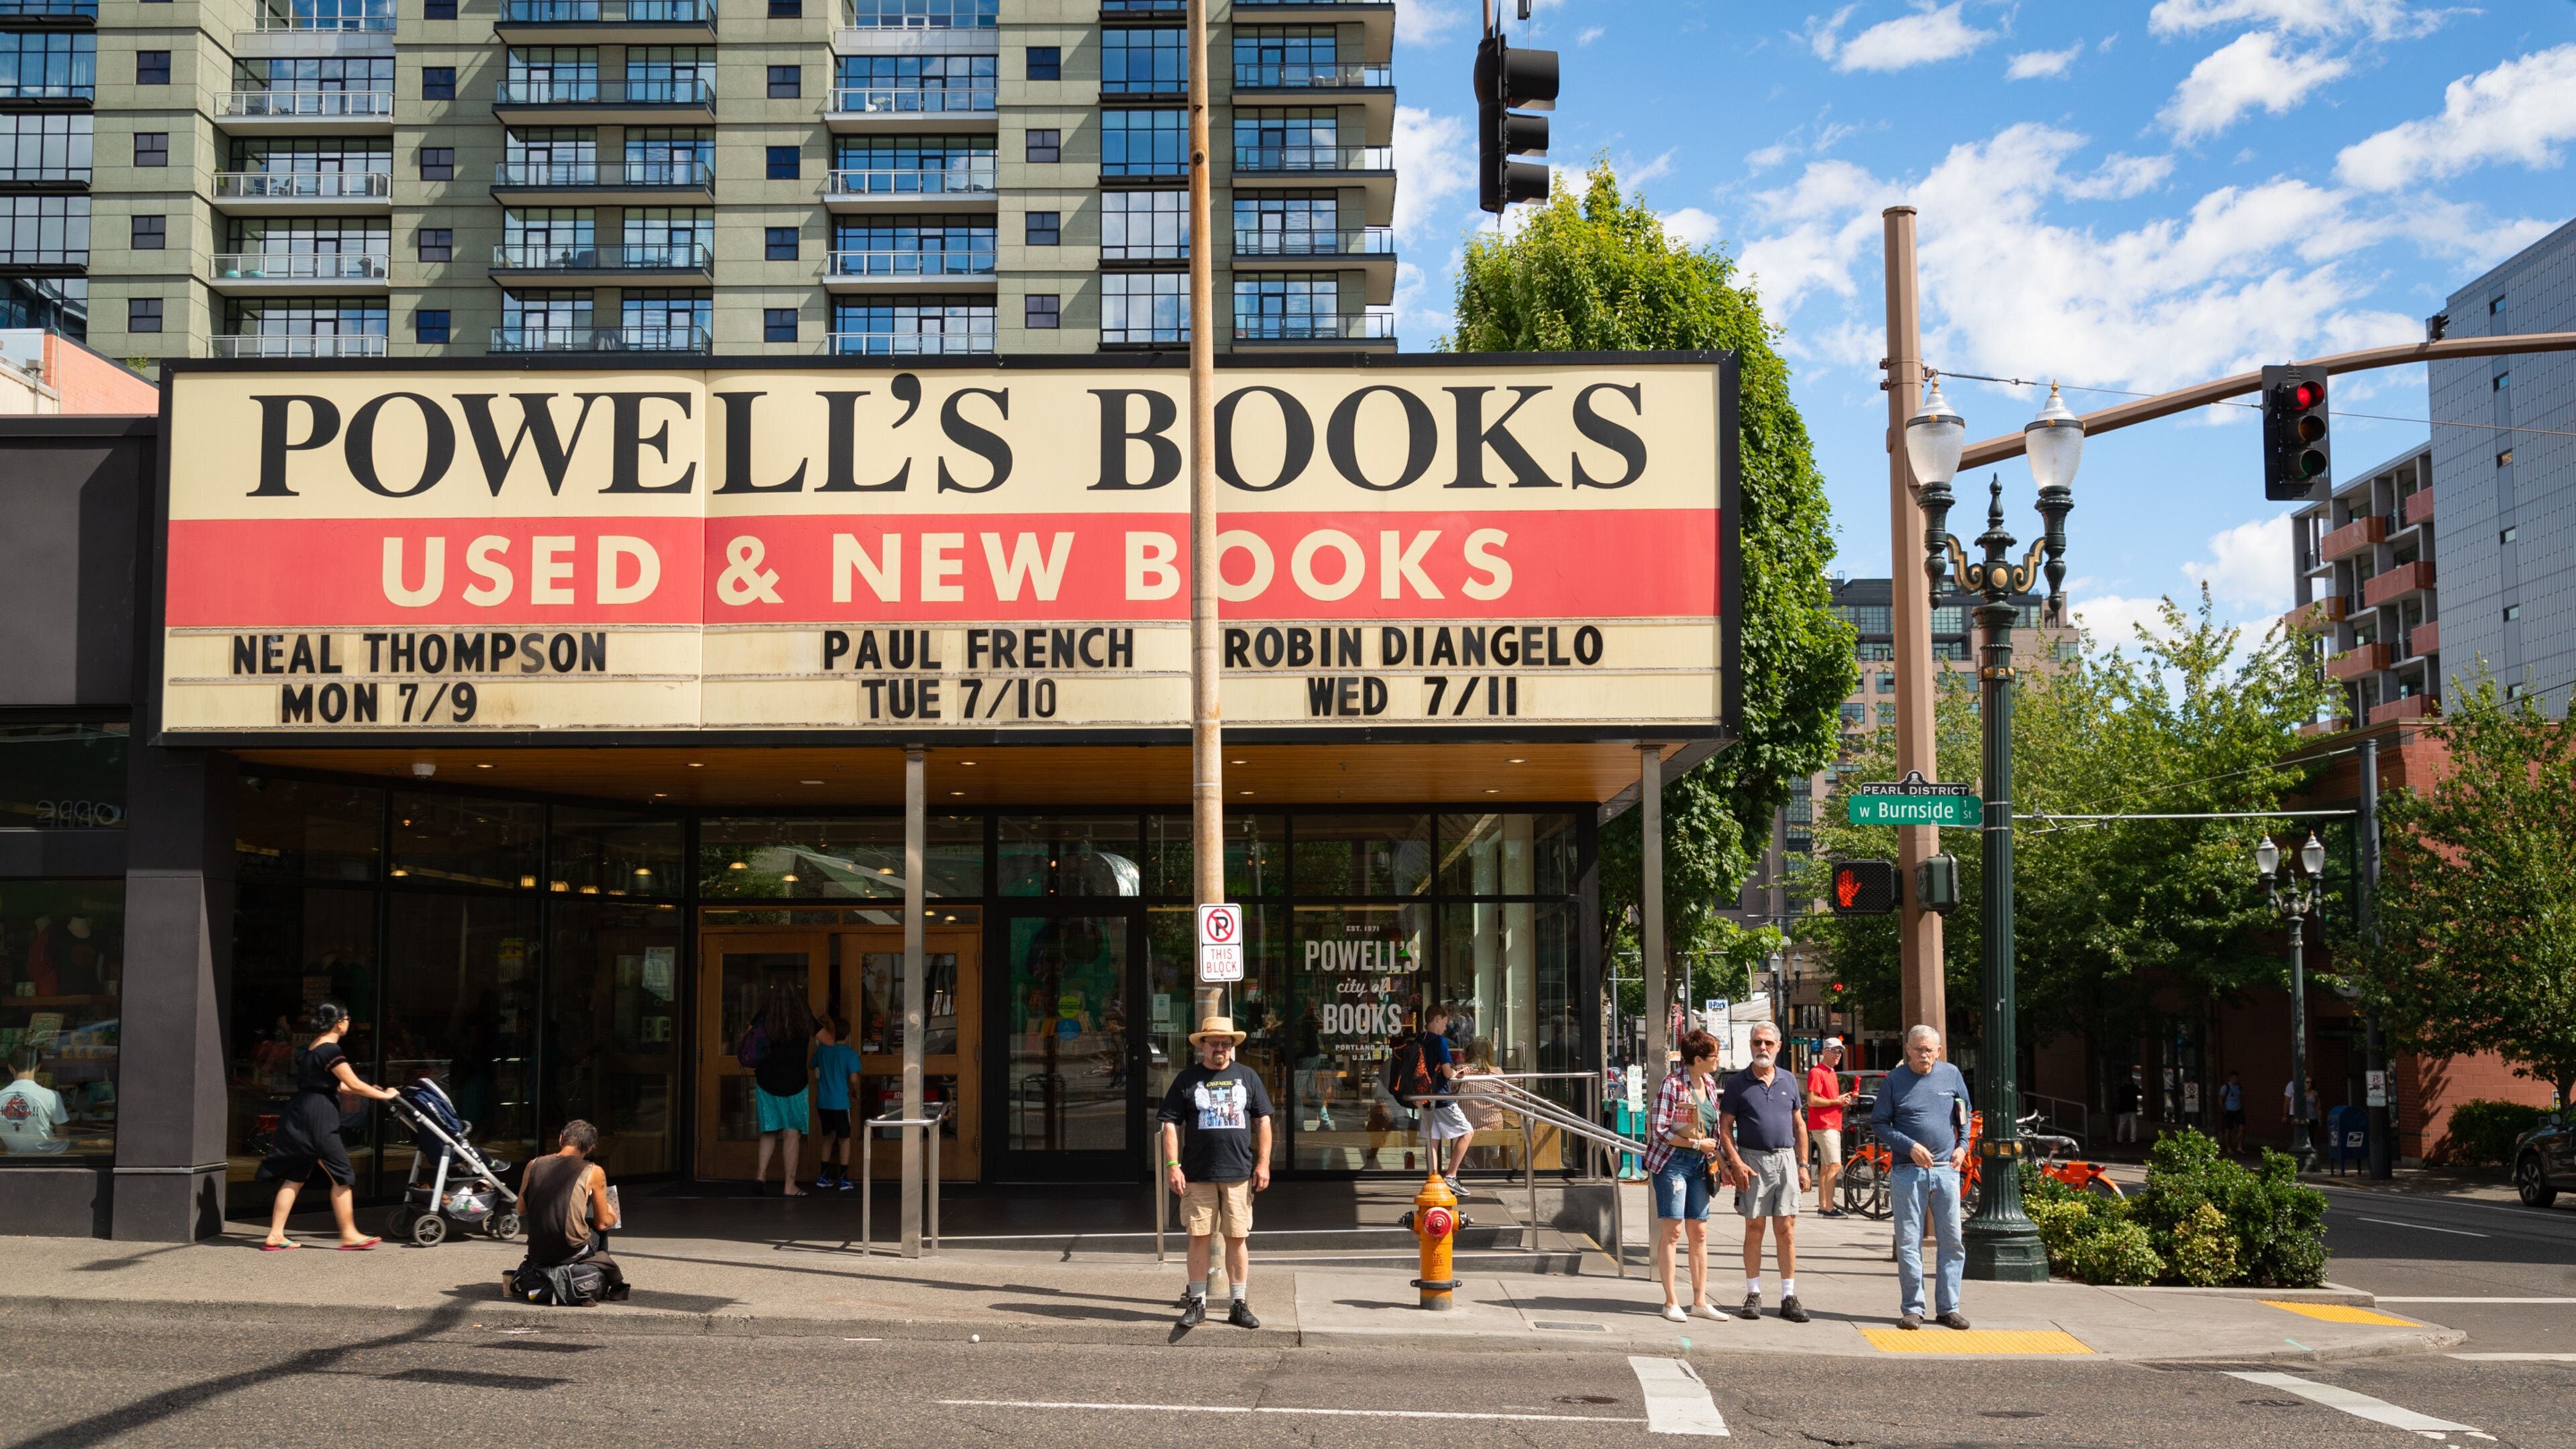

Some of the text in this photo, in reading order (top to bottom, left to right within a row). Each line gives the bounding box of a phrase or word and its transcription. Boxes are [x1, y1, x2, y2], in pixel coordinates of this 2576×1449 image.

[246, 372, 1647, 498] POWELL'S BOOKS
[382, 528, 1514, 607] USED & NEW BOOKS
[233, 632, 606, 675] NEAL THOMPSON
[824, 627, 1134, 670] PAUL FRENCH
[1224, 625, 1603, 668] ROBIN DIANGELO
[282, 682, 478, 724] MON 7/9
[861, 678, 1057, 719] TUE 7/10
[1307, 676, 1517, 716] WED 7/11
[1863, 786, 1968, 796] PEARL DISTRICT
[1962, 799, 1967, 808] 1
[1878, 801, 1954, 818] Burnside
[1963, 810, 1972, 819] St
[1206, 961, 1237, 973] BLOCK
[1211, 948, 1233, 960] THIS
[1305, 940, 1421, 971] POWELL'S
[1336, 977, 1389, 1000] city of
[1323, 1003, 1402, 1035] BOOKS
